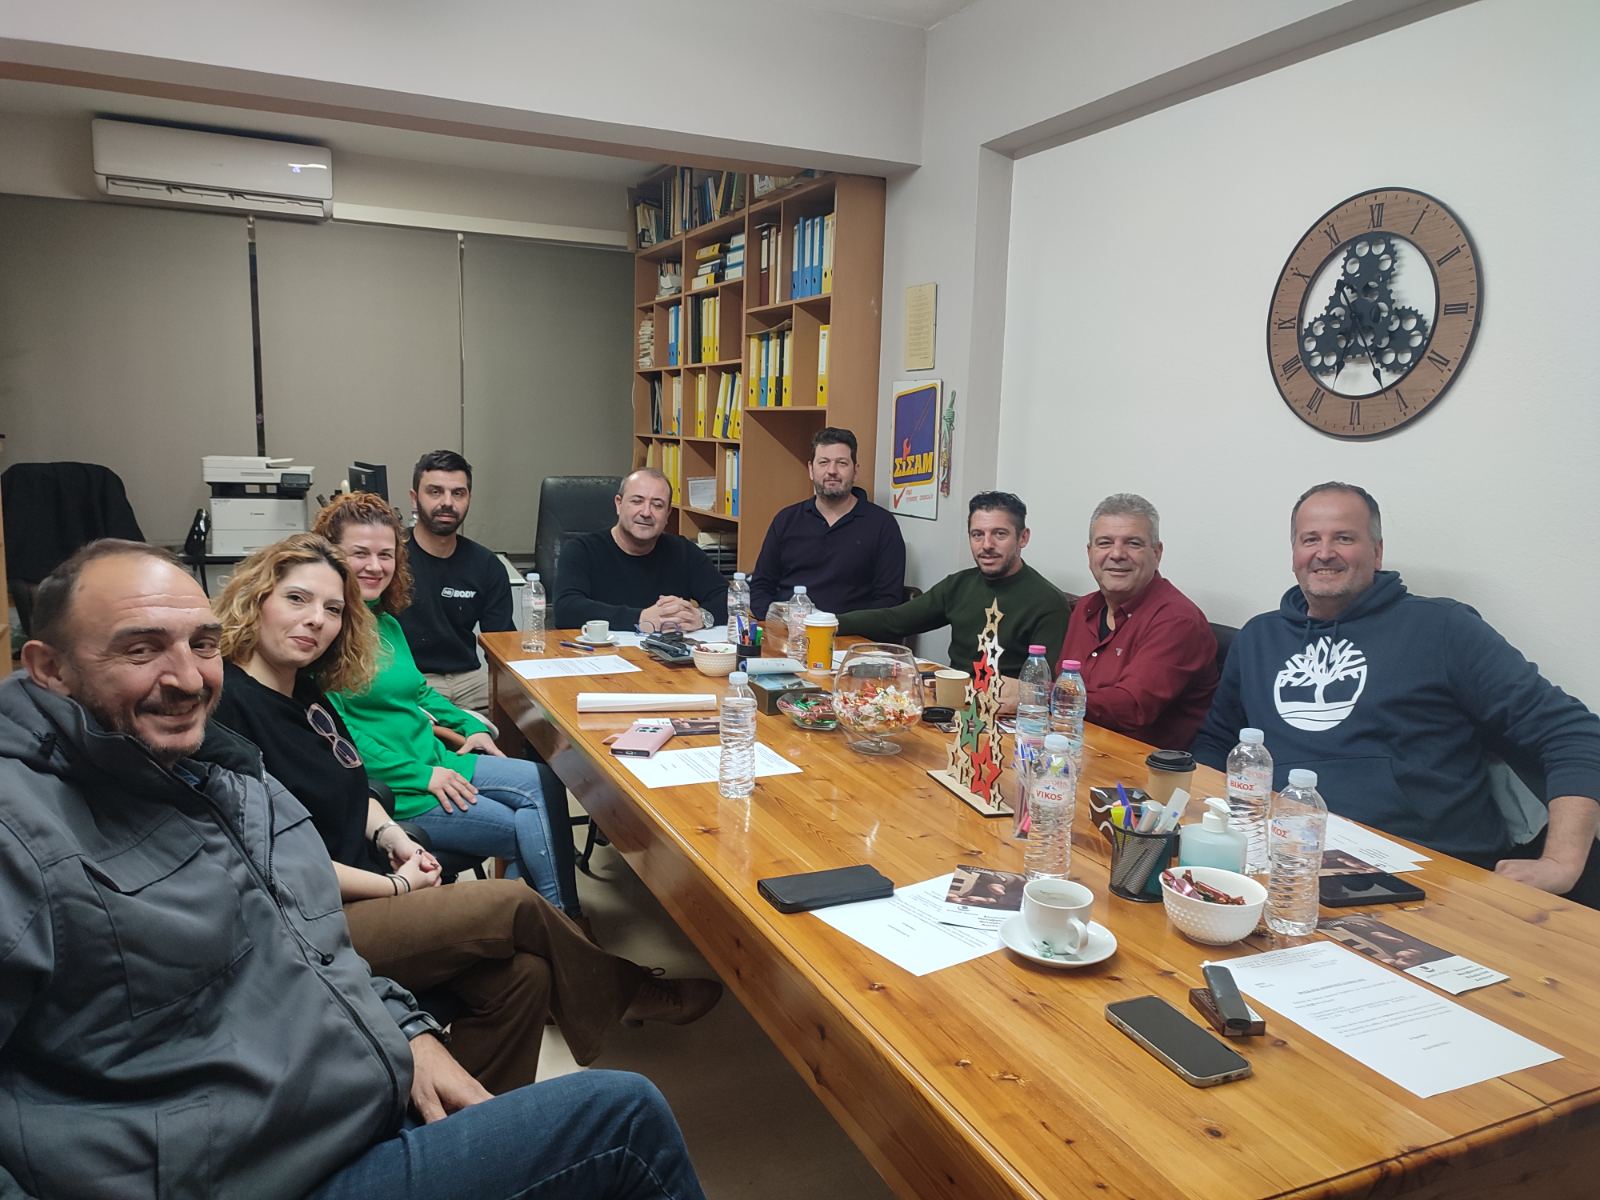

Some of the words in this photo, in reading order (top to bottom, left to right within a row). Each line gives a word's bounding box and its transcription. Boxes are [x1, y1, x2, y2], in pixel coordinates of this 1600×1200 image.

[1368, 203, 1384, 228] XII
[1324, 224, 1340, 249] XI
[1437, 247, 1460, 266] II
[1293, 267, 1311, 284] X
[1444, 302, 1469, 316] III
[1278, 316, 1297, 330] IX
[1282, 354, 1302, 380] VIII
[1427, 350, 1450, 373] IV
[1307, 387, 1325, 414] VII
[1395, 389, 1409, 412] V
[1350, 401, 1360, 425] VI
[454, 590, 477, 598] BODY
[1036, 790, 1063, 801] VIKOS
[1230, 780, 1255, 791] ΒΙΚΟΣ
